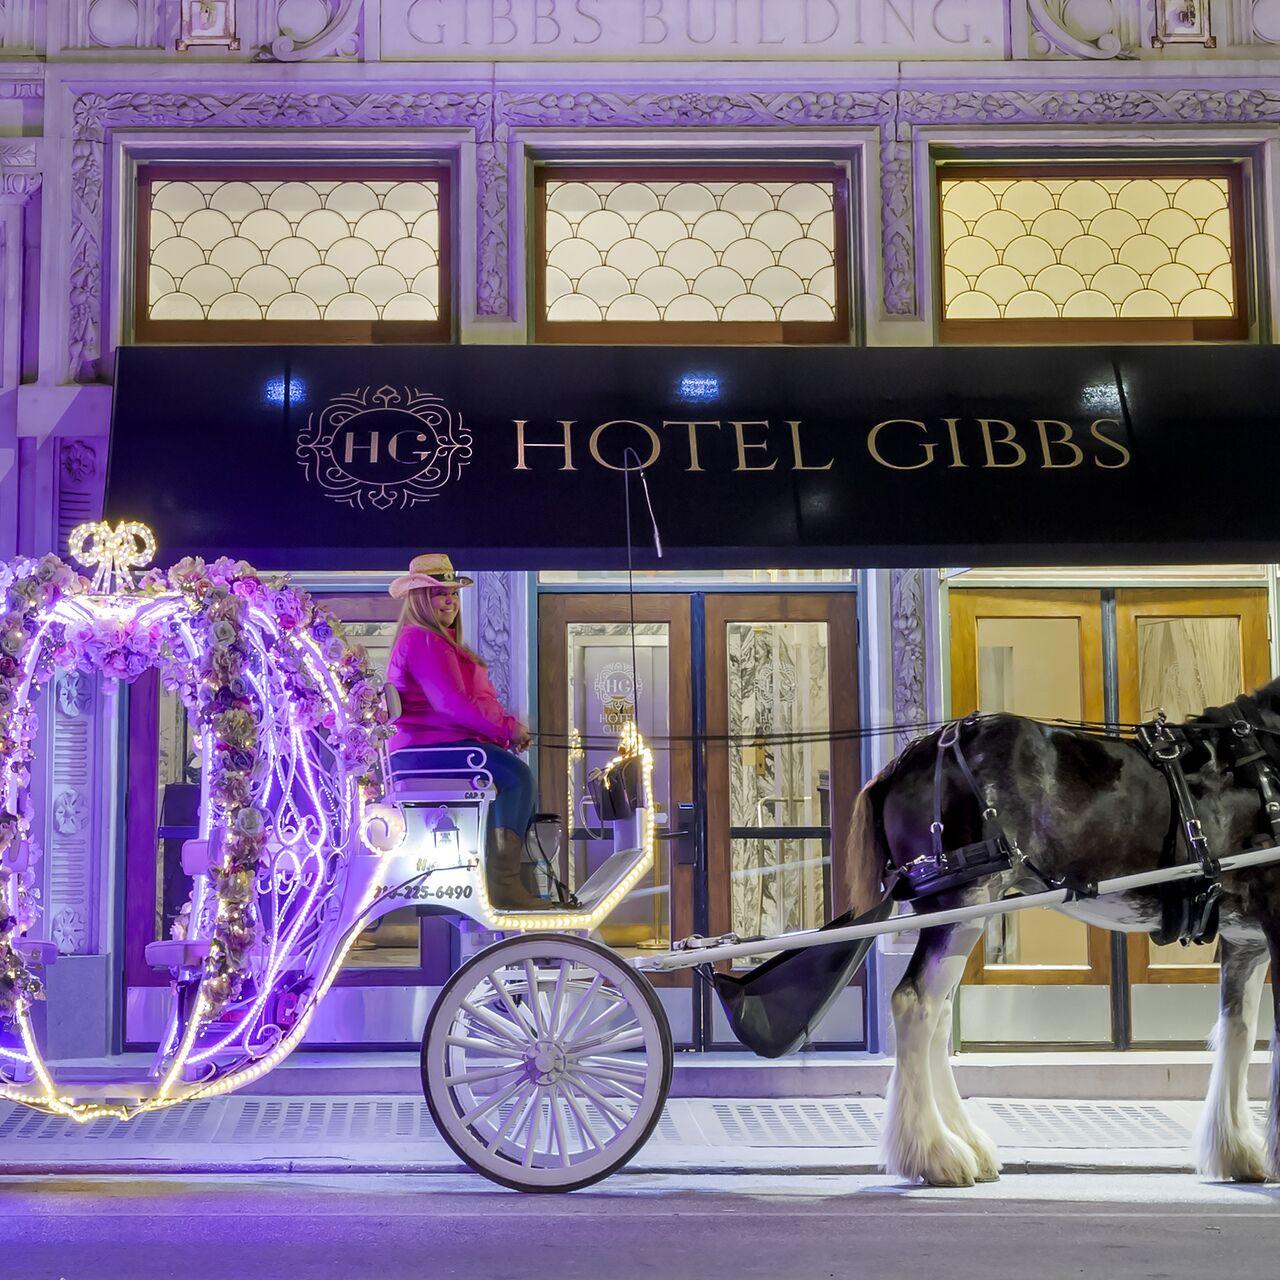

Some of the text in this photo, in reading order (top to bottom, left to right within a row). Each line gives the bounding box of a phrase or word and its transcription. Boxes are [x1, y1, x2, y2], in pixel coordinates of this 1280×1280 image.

[344, 429, 432, 465] HG
[512, 417, 1131, 471] HOTEL GIBBS
[606, 679, 632, 693] HG
